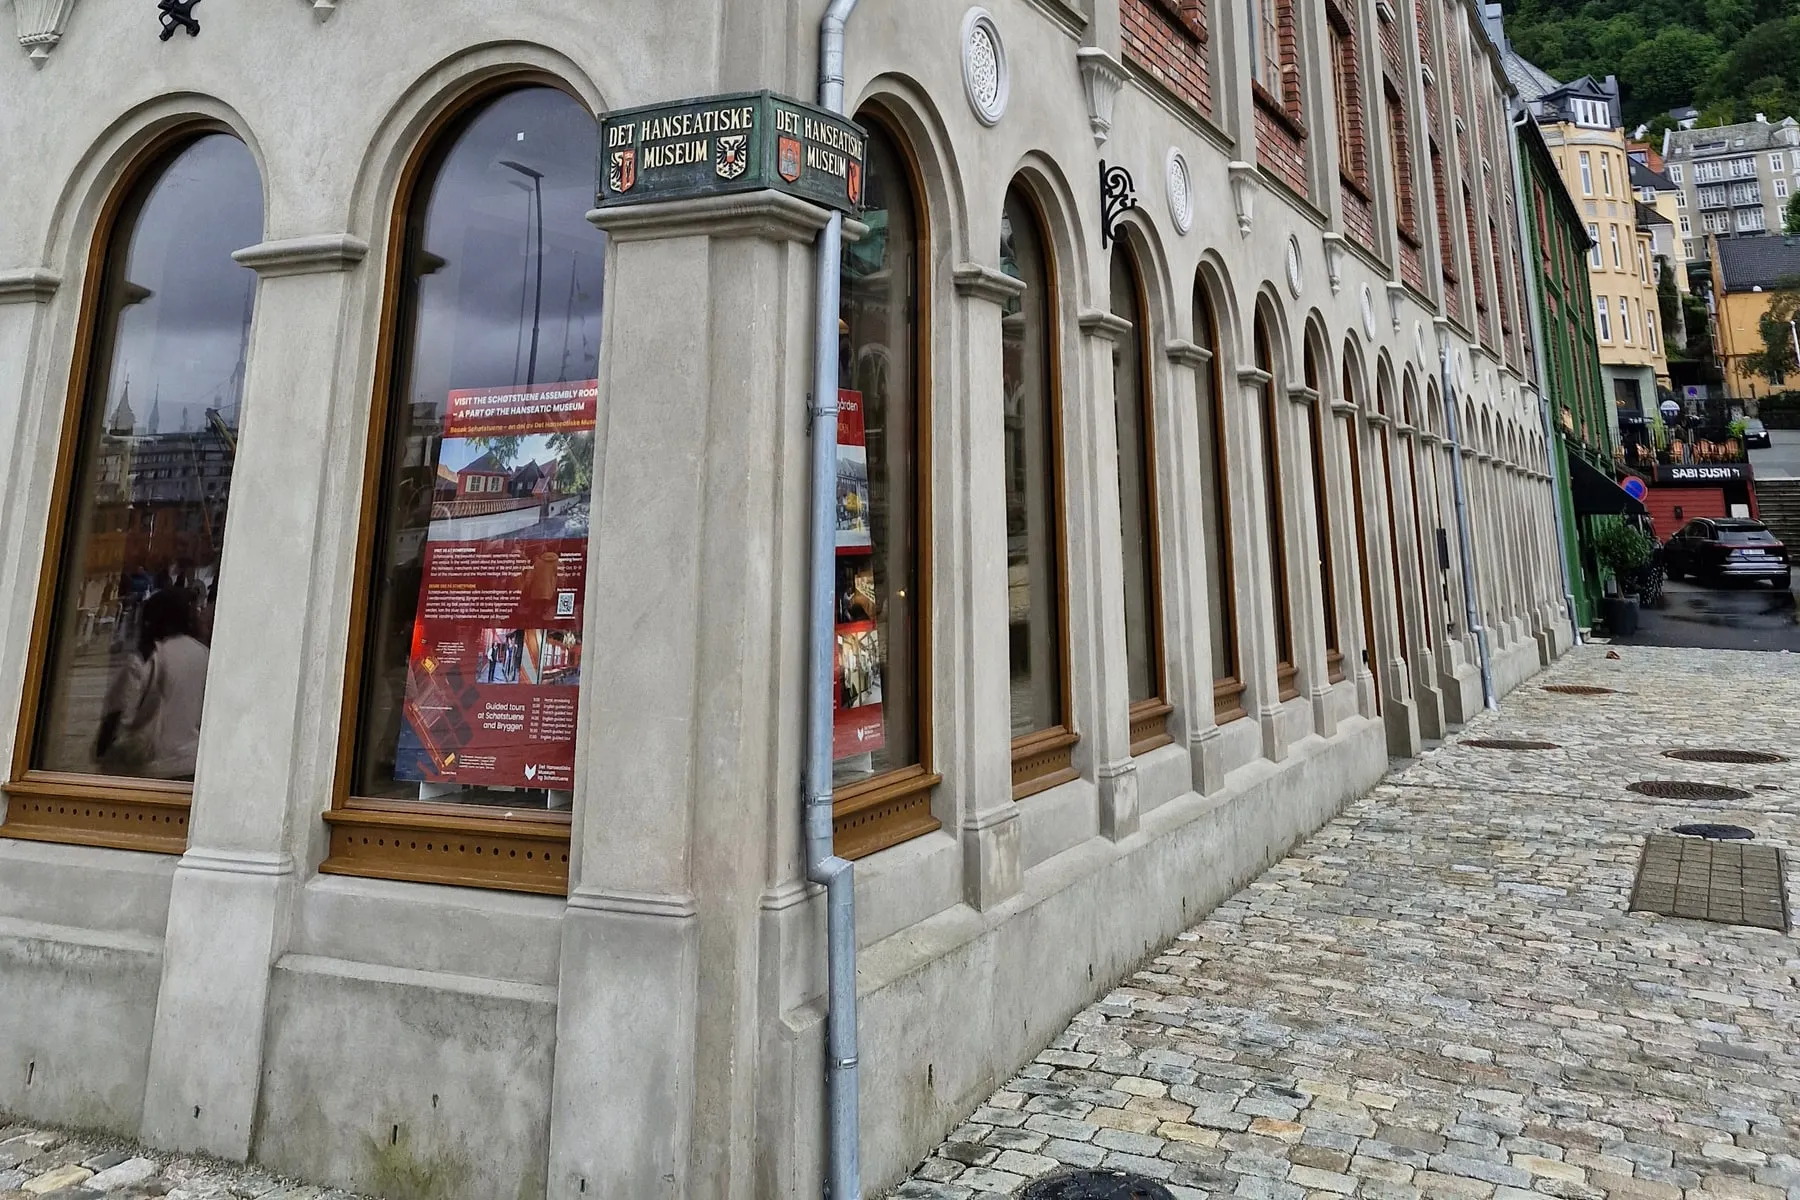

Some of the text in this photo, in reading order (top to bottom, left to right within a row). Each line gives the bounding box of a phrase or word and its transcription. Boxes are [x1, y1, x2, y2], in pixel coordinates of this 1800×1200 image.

[609, 107, 753, 147] DET HANSEATISKE
[776, 109, 862, 160] DET HANSEATISKE
[644, 140, 708, 169] MUSEUM
[807, 147, 846, 179] MUSEUM
[454, 397, 472, 406] VISIT
[474, 396, 486, 404] THE
[488, 393, 539, 404] SCHØTSTUENE
[540, 390, 578, 400] ASSEMBLY
[465, 409, 484, 418] PART
[485, 408, 495, 416] OF
[496, 407, 509, 415] THE
[510, 404, 551, 414] HANSEATIC
[553, 402, 584, 411] MUSEUM
[1672, 468, 1731, 478] SABI SUSHI
[497, 722, 523, 732] Bryggen
